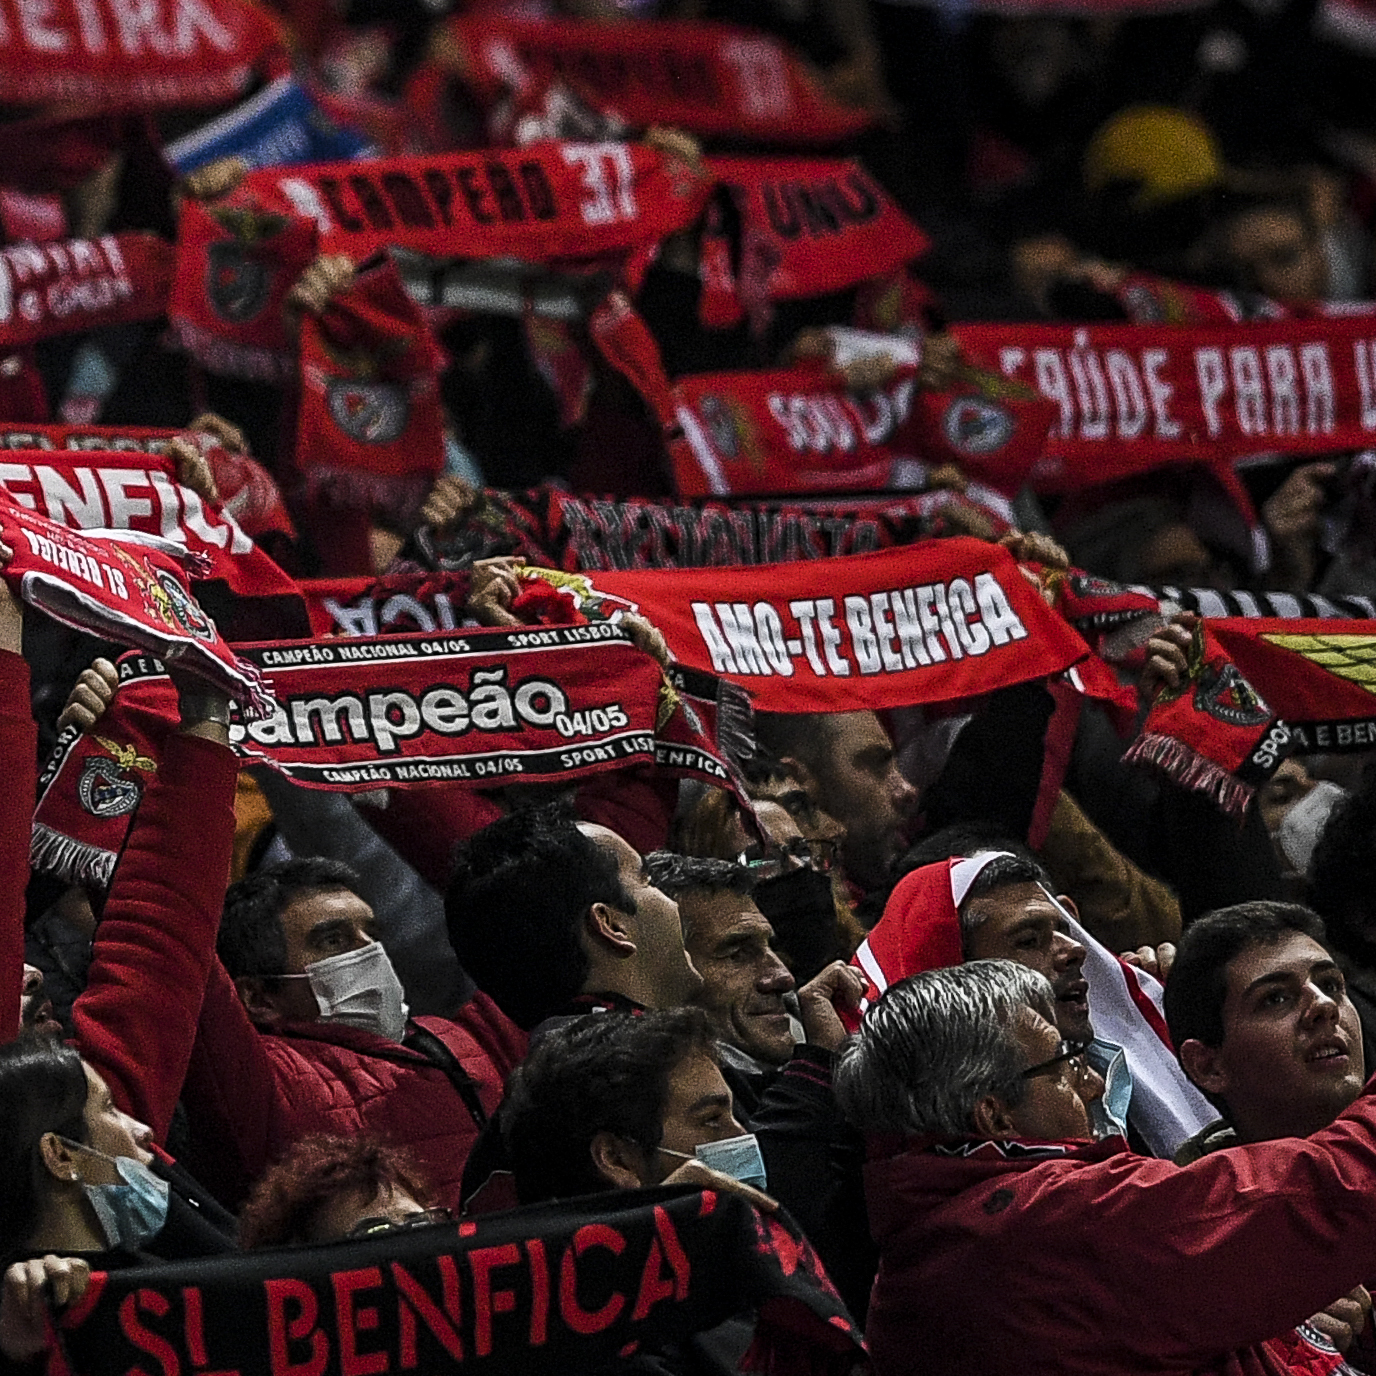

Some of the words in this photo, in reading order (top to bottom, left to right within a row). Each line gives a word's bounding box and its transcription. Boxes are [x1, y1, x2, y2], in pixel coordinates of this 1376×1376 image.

[1192, 341, 1338, 440] PARA
[261, 644, 334, 666] CAMPEÃO
[340, 641, 417, 660] NACIONAL
[421, 637, 471, 655] 04/05
[507, 629, 560, 648] SPORT
[844, 569, 1028, 676] BENFICA
[556, 704, 629, 737] 04/05
[321, 762, 391, 783] CAMPEÃO
[394, 759, 471, 781] NACIONAL
[474, 756, 523, 776] 04/05
[559, 744, 617, 769] SPORT
[117, 1288, 240, 1376] SL
[264, 1204, 694, 1376] BENFICA
